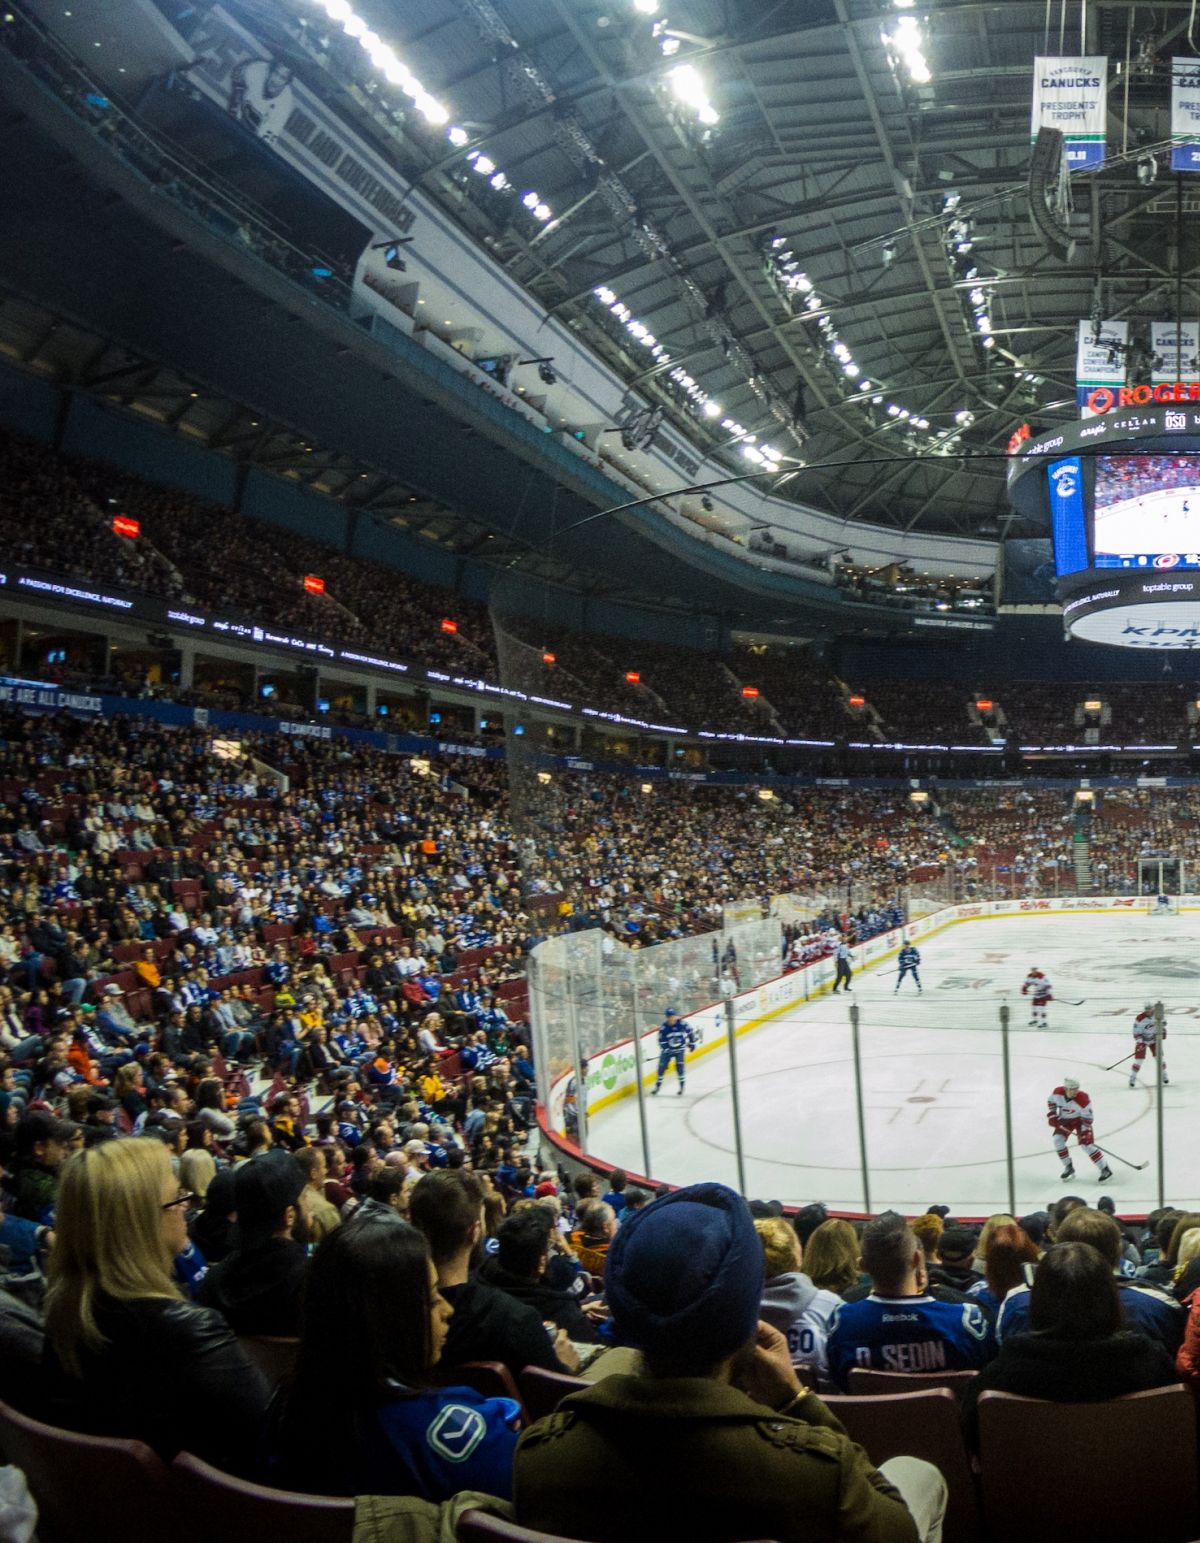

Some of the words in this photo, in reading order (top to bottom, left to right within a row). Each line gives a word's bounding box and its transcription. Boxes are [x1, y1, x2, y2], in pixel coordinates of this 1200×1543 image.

[1041, 78, 1100, 88] CANUCKS
[1051, 112, 1086, 120] TROPHY
[1114, 419, 1156, 429] CELLAR
[1165, 415, 1186, 428] OSO
[1172, 583, 1194, 592] group
[16, 688, 36, 704] ARE
[38, 691, 56, 706] ALL
[57, 693, 102, 711] CANUCKS
[881, 1340, 947, 1372] SEDIN
